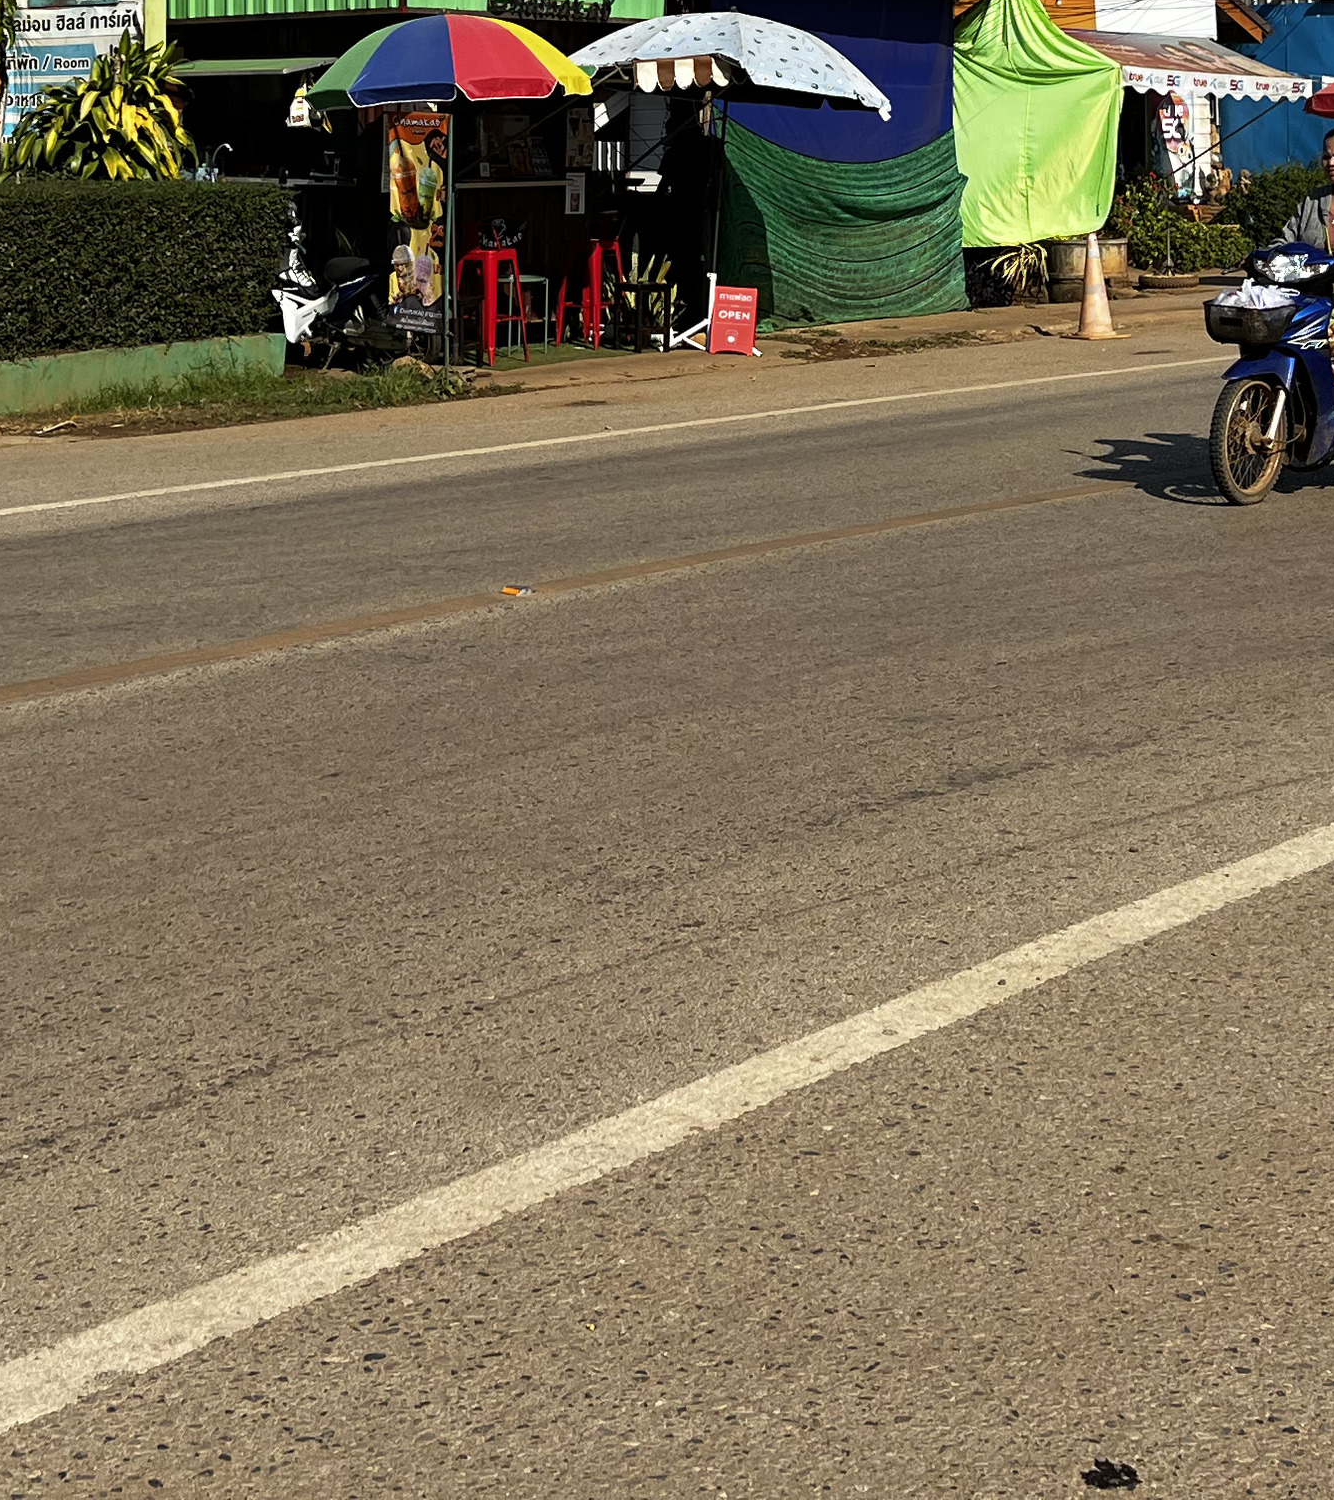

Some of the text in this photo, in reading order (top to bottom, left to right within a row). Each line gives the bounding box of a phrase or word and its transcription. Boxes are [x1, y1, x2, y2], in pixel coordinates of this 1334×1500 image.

[14, 14, 51, 33] ลม่อน
[54, 57, 89, 69] Room
[1129, 71, 1144, 81] true
[1167, 74, 1181, 87] 5G
[1193, 77, 1208, 88] true
[1229, 79, 1244, 92] 5G
[1255, 81, 1270, 91] true
[1291, 82, 1306, 94] 5G
[718, 310, 750, 320] OPEN
